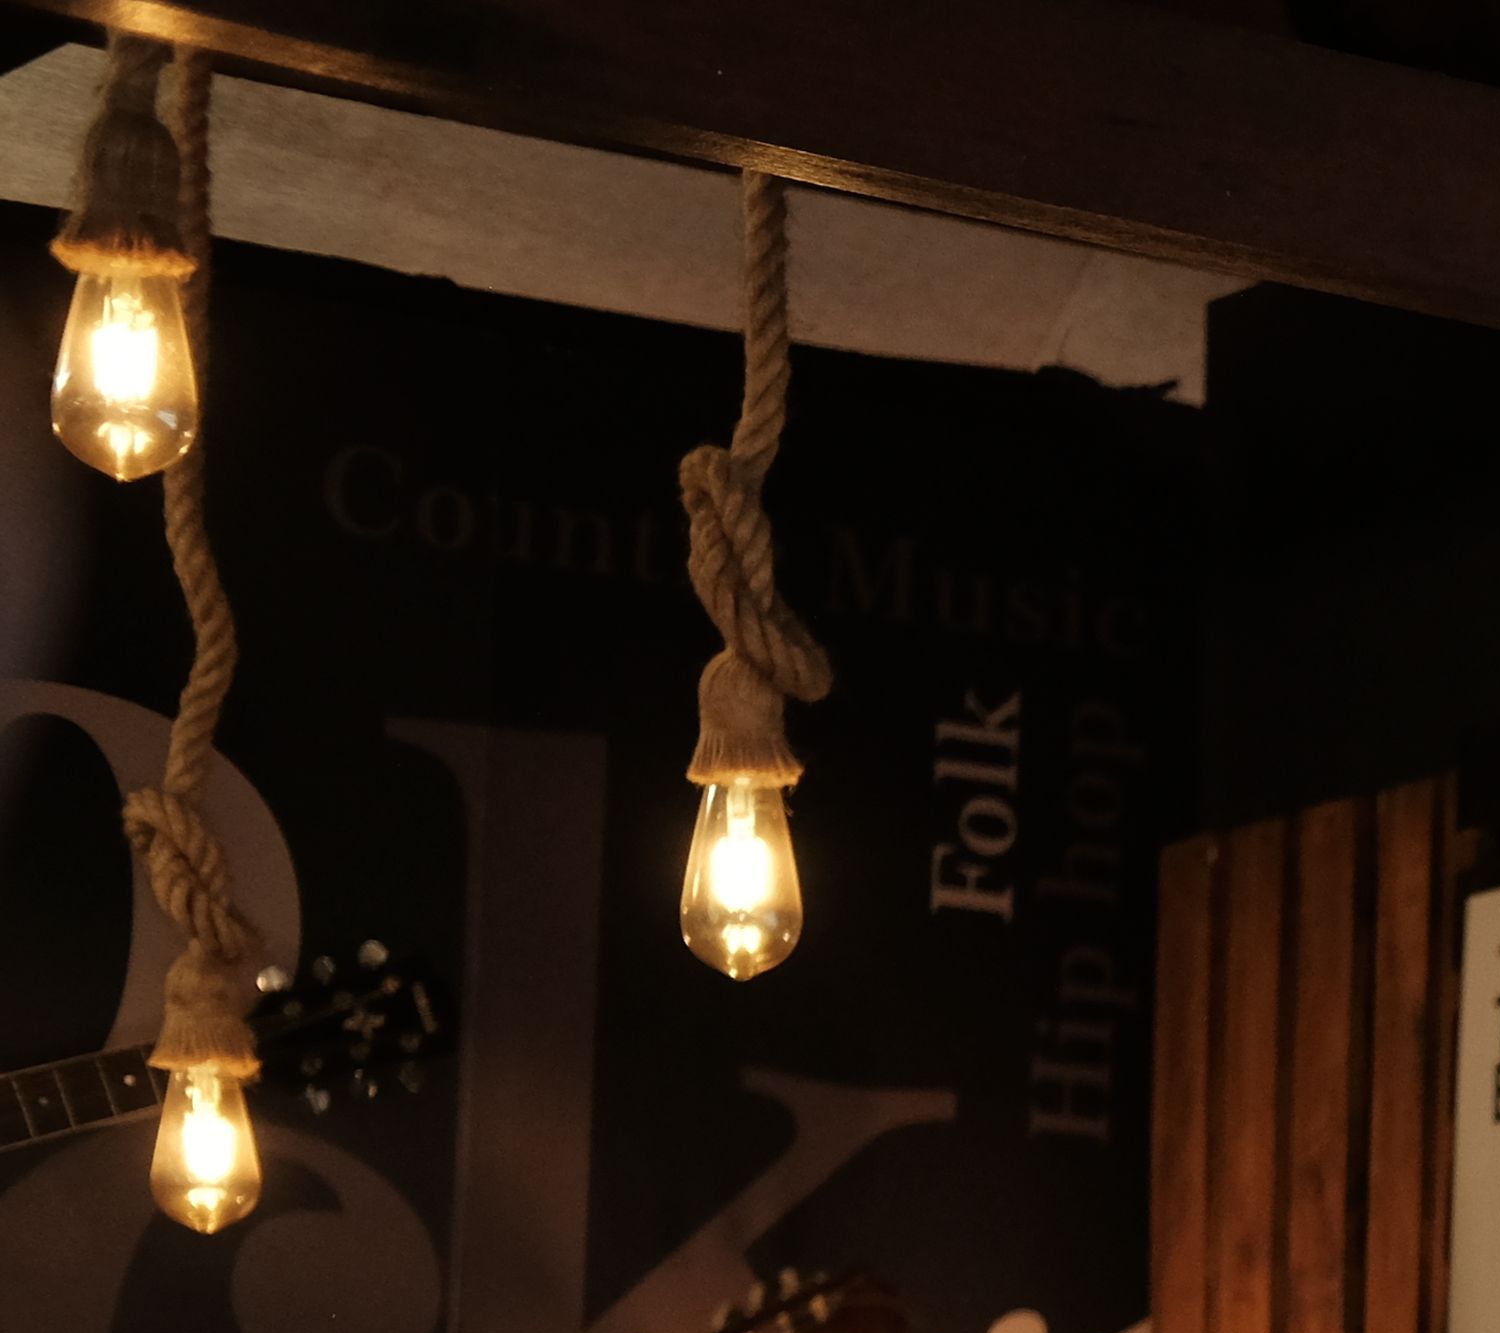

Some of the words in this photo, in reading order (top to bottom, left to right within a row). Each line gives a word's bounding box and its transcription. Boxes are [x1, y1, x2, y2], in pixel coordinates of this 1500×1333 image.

[826, 521, 1149, 660] Music
[927, 682, 1025, 926] Folk
[1034, 698, 1149, 909] hop
[1027, 944, 1140, 1146] Hip
